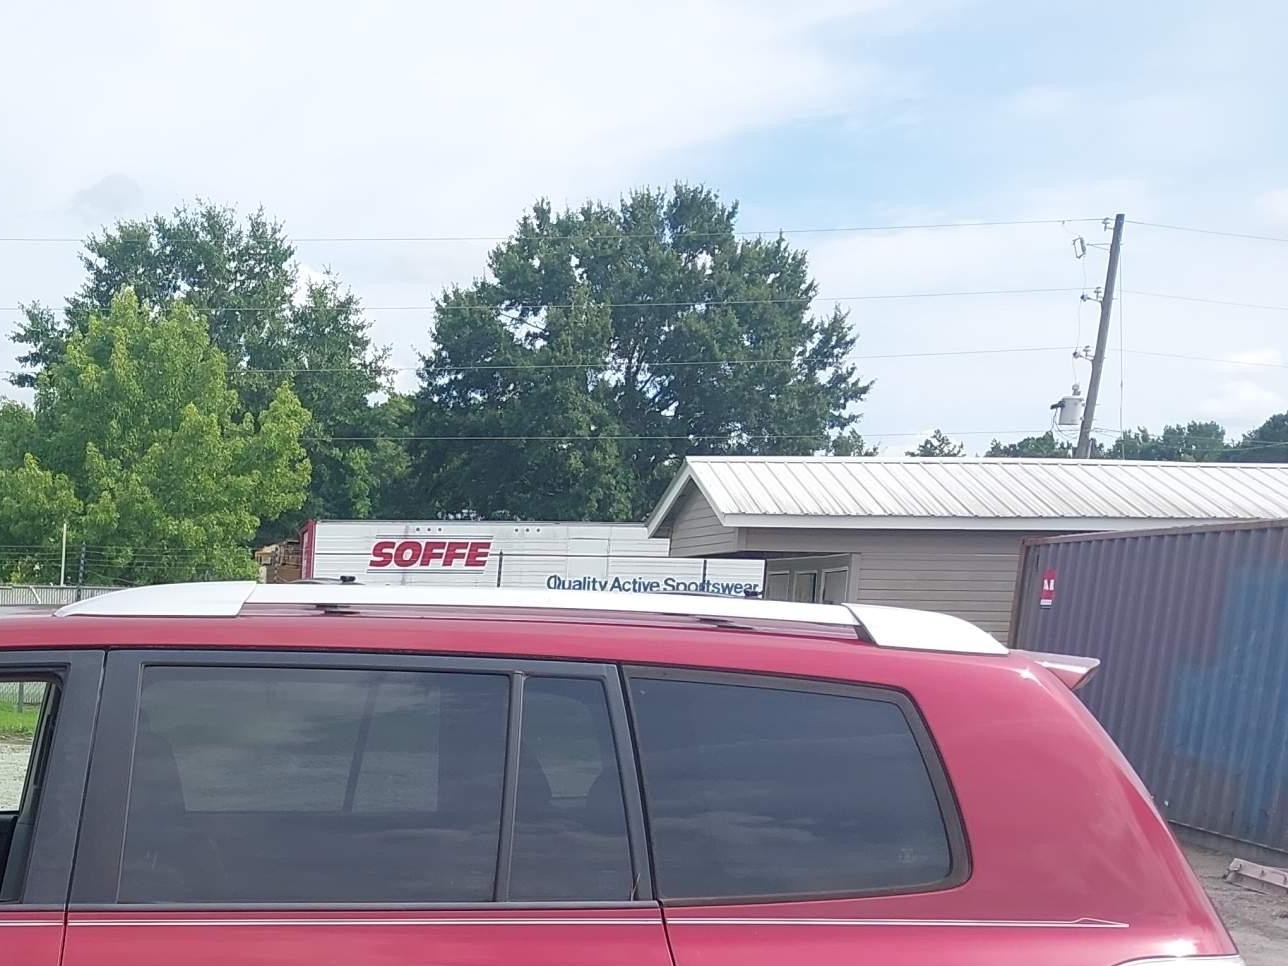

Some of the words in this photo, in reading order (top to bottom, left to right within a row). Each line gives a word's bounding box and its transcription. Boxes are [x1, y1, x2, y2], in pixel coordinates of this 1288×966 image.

[368, 540, 492, 568] SOFFE
[546, 574, 609, 592] Quality
[610, 576, 661, 593] Active
